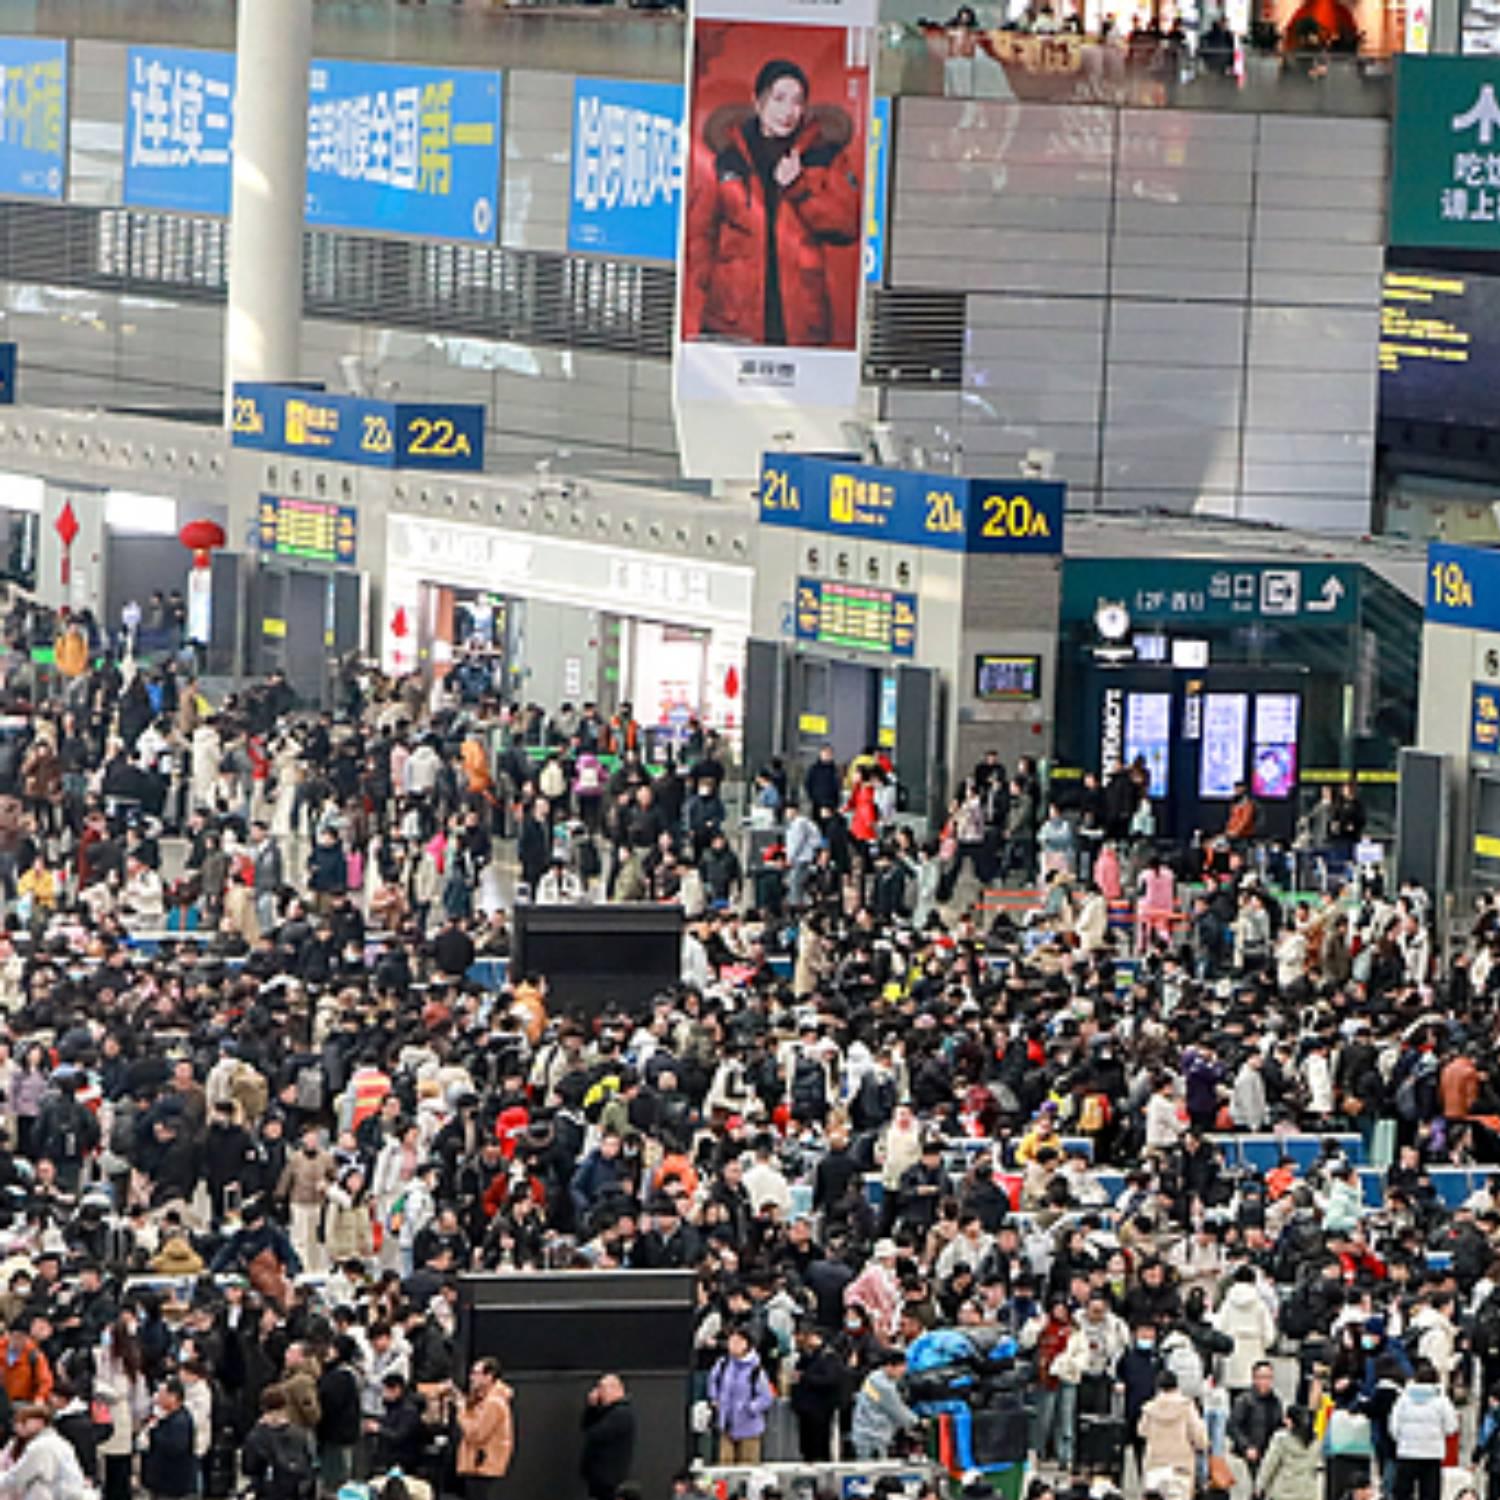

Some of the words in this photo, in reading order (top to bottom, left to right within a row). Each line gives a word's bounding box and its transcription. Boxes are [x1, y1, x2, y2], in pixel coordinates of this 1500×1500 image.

[407, 417, 472, 459] 22A
[762, 469, 800, 511] 21A
[924, 491, 964, 534] 20A
[981, 495, 1051, 538] 20A
[1431, 561, 1474, 607] 19A
